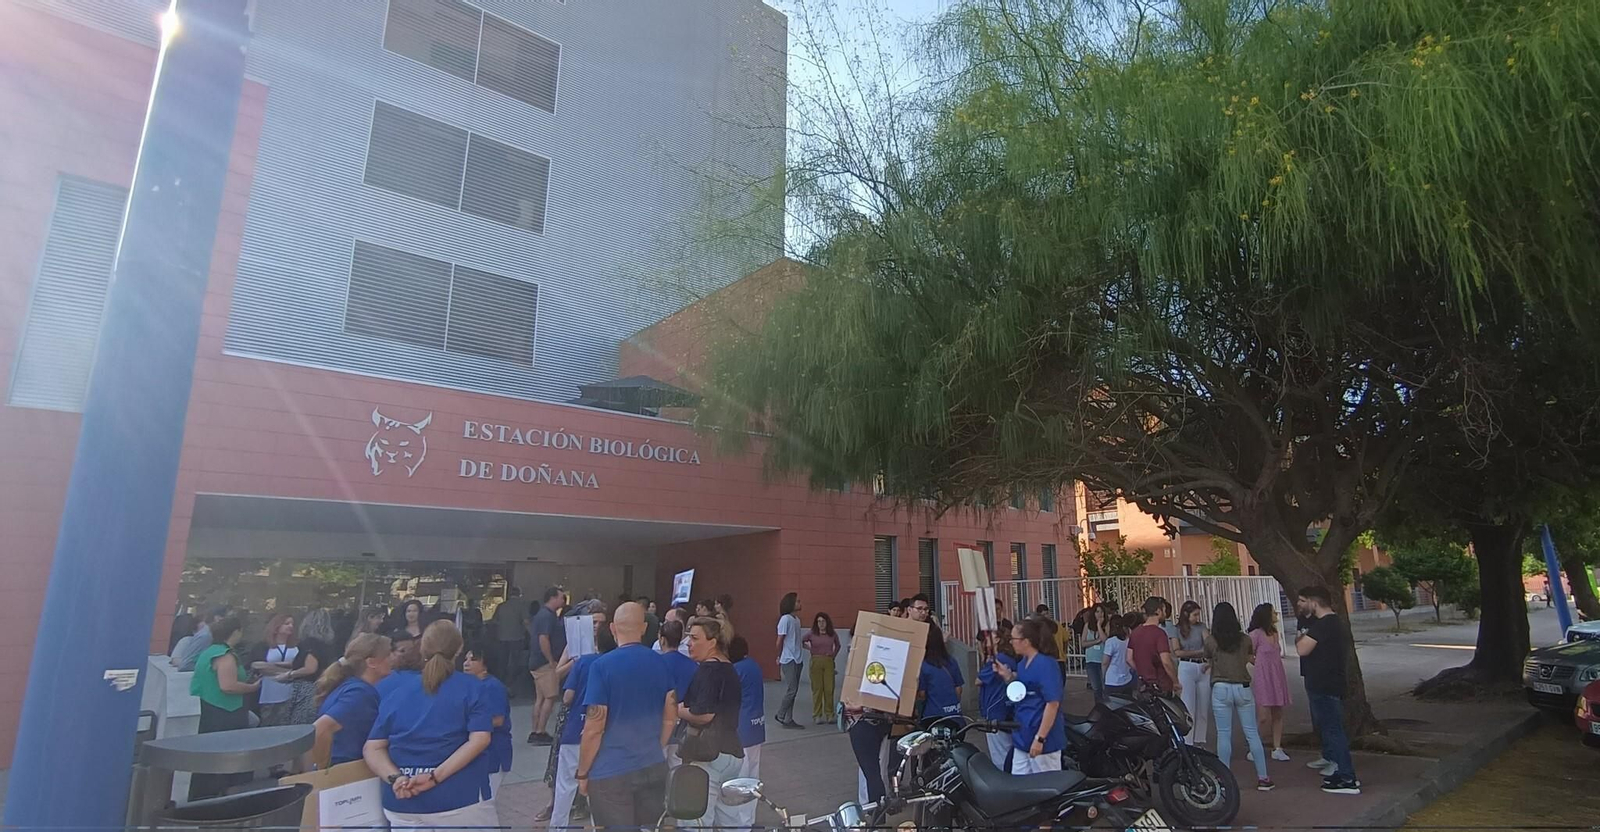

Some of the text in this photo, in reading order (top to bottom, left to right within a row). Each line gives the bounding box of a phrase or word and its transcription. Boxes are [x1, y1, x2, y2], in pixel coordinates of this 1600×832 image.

[463, 420, 701, 465] ESTACIÓN BIOLÓGICA
[459, 459, 600, 489] DE DOÑANA
